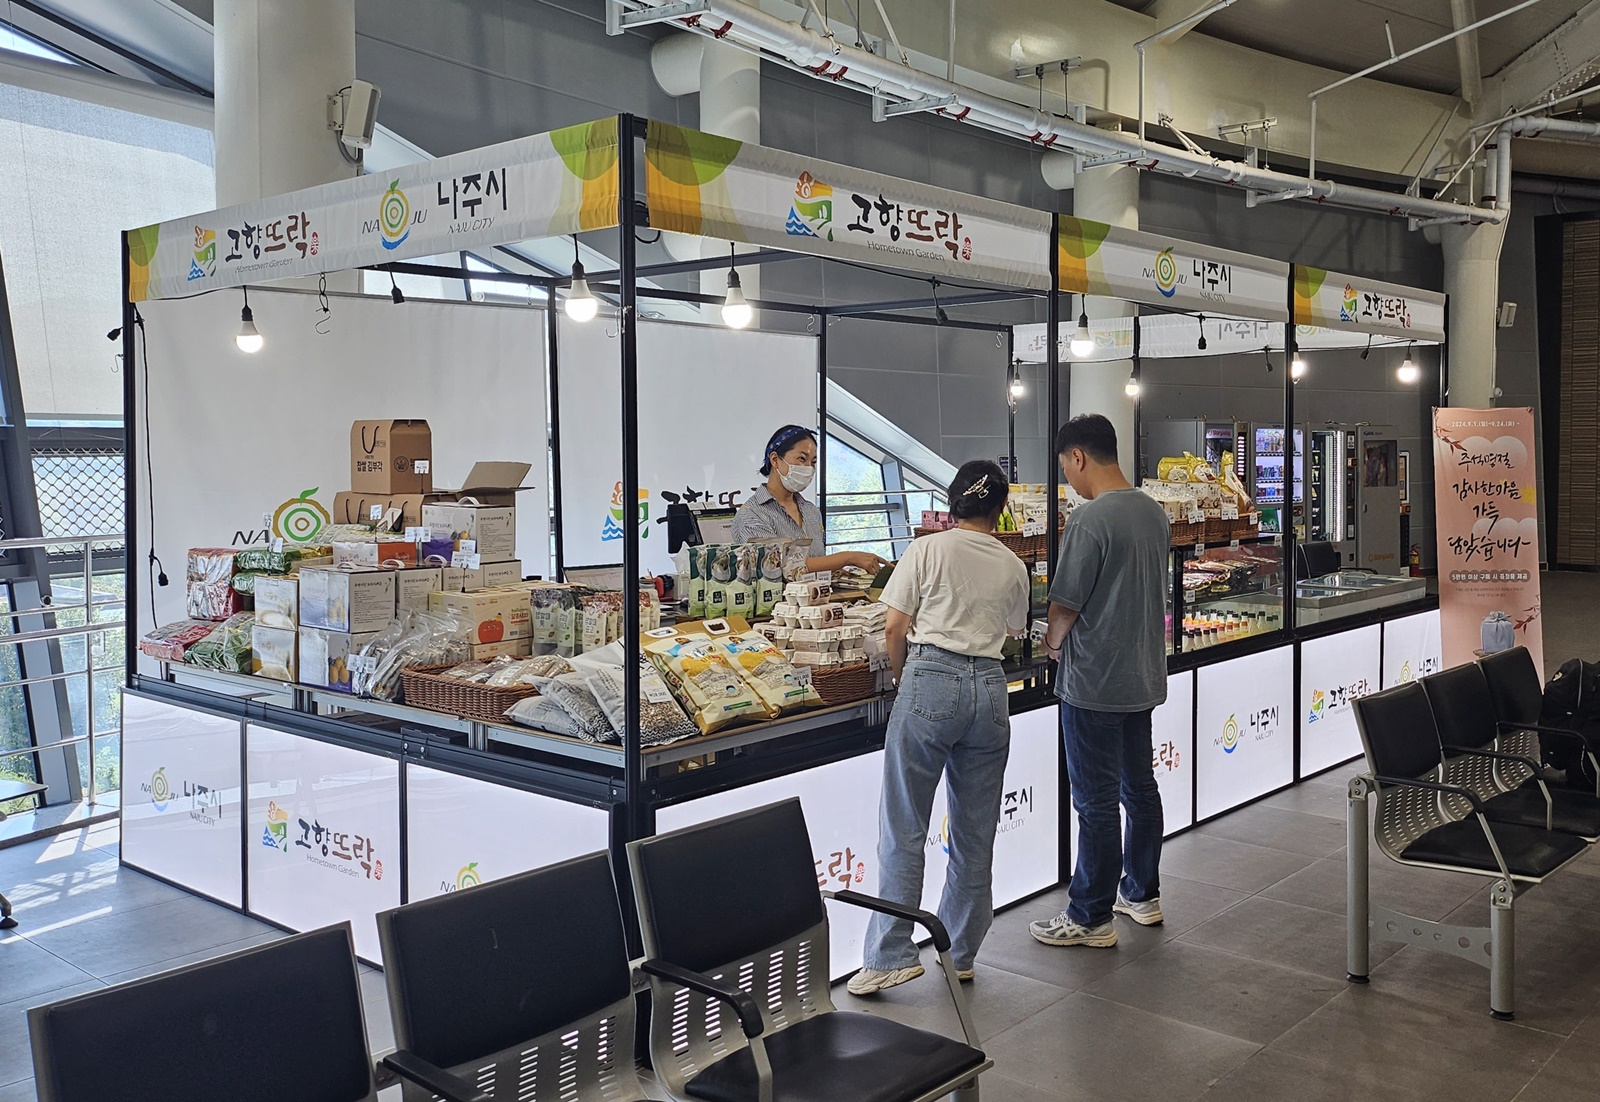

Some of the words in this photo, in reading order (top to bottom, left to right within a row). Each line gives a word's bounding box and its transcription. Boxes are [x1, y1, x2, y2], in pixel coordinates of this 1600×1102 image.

[438, 167, 507, 219] 나주시
[225, 211, 311, 262] 고향뜨락
[847, 193, 963, 260] 고향뜨락
[235, 262, 269, 274] Hometown
[269, 257, 293, 267] Garden
[867, 240, 915, 257] Hometown
[915, 248, 945, 261] Garden
[1193, 258, 1231, 293] 나주시
[1362, 291, 1407, 328] 고향뜨락
[367, 461, 383, 472] 김부각
[1473, 501, 1499, 535] 가득
[1250, 705, 1279, 733] 나주시
[184, 780, 222, 819] 나주시
[295, 818, 374, 879] 고향뜨락
[306, 853, 338, 871] Hometown
[338, 864, 360, 878] Garden
